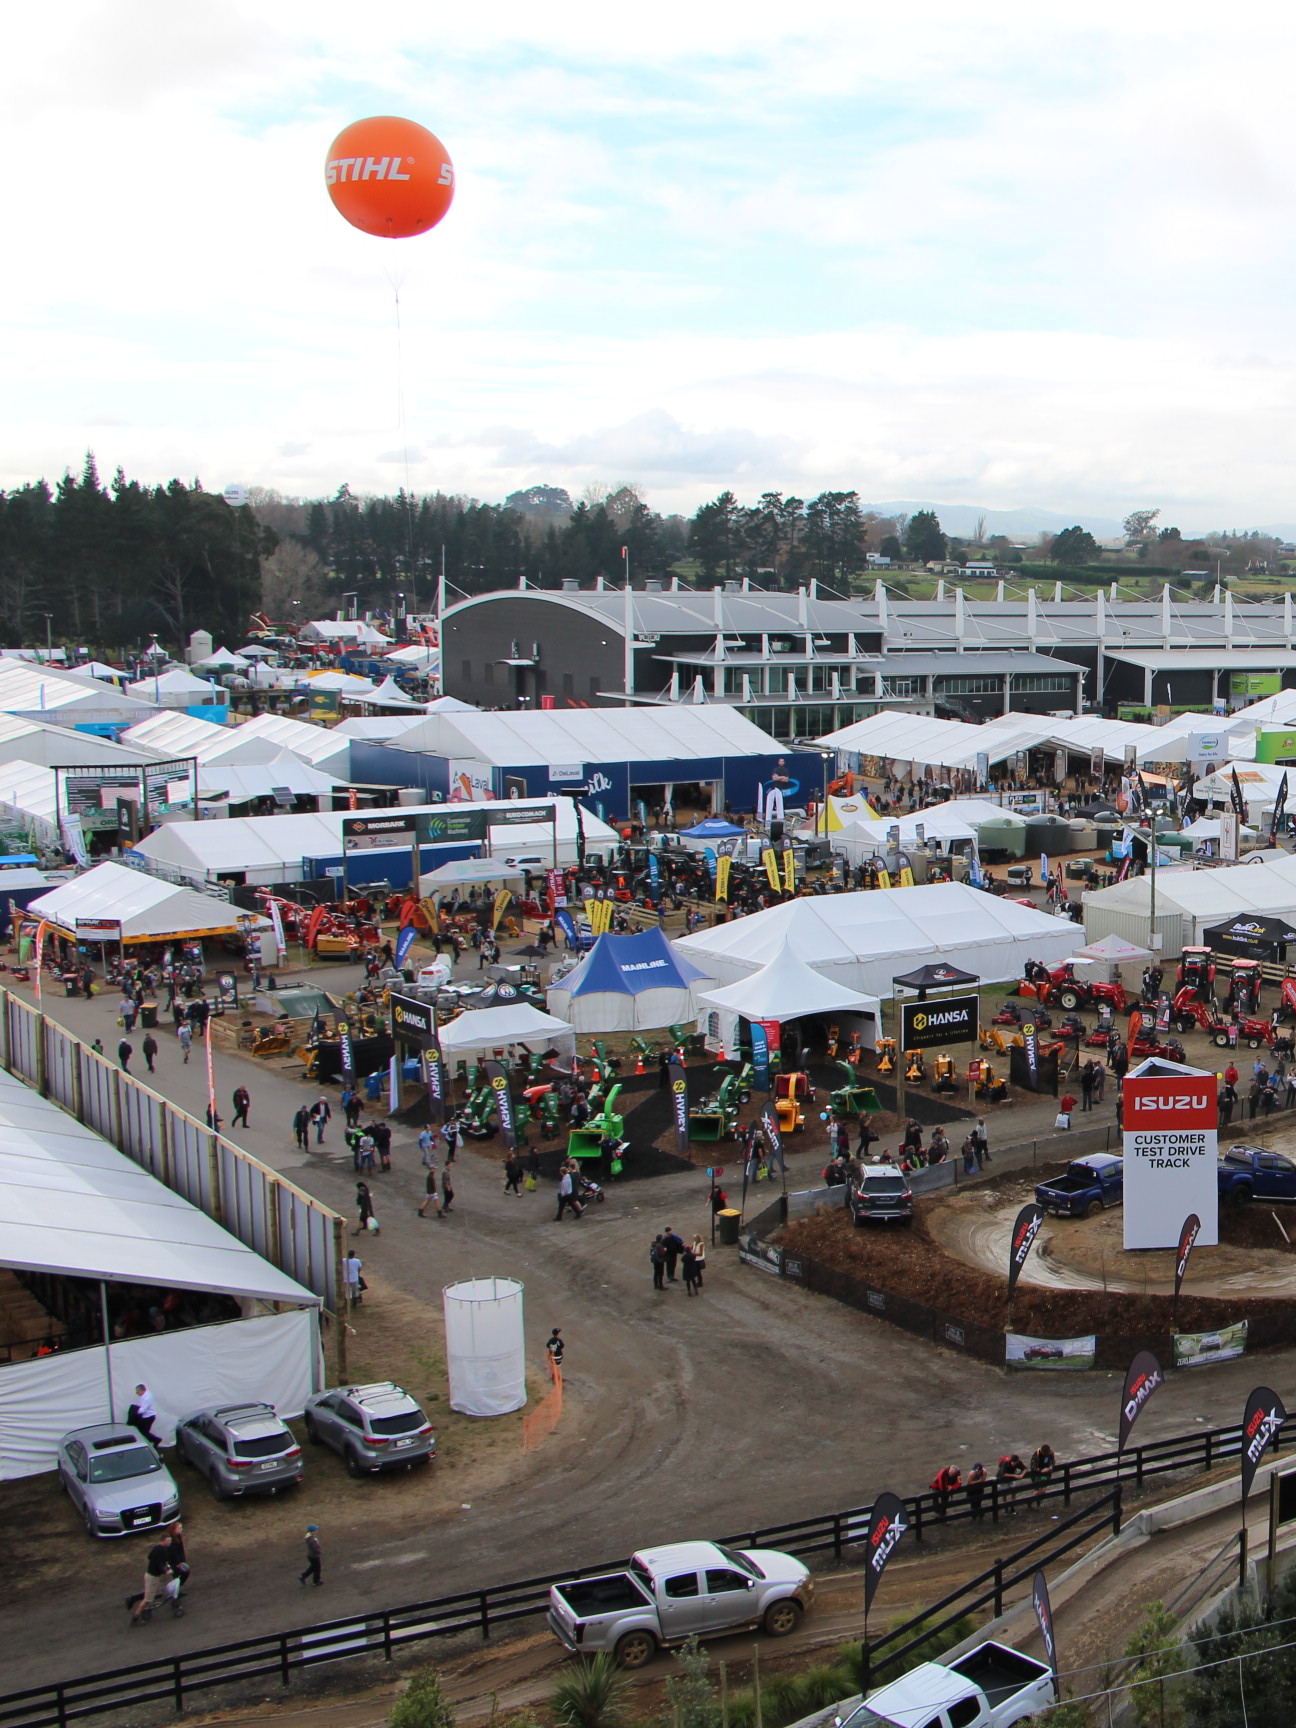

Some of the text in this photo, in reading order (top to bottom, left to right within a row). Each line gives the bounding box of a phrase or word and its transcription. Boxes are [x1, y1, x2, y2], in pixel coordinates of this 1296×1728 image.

[327, 157, 410, 185] STIHL
[368, 820, 406, 829] MORBARK
[403, 1010, 426, 1030] HANSA
[928, 1010, 968, 1026] HANSA
[1134, 1095, 1208, 1111] ISUZU
[1134, 1133, 1206, 1145] CUSTOMER
[1134, 1145, 1206, 1157] TEST DRIVE
[1148, 1157, 1190, 1169] TRACK
[1015, 1222, 1029, 1248] ISUZU
[1124, 1371, 1162, 1421] D-MAX
[1247, 1408, 1264, 1438] ISUZU
[871, 1516, 889, 1547] ISUZU
